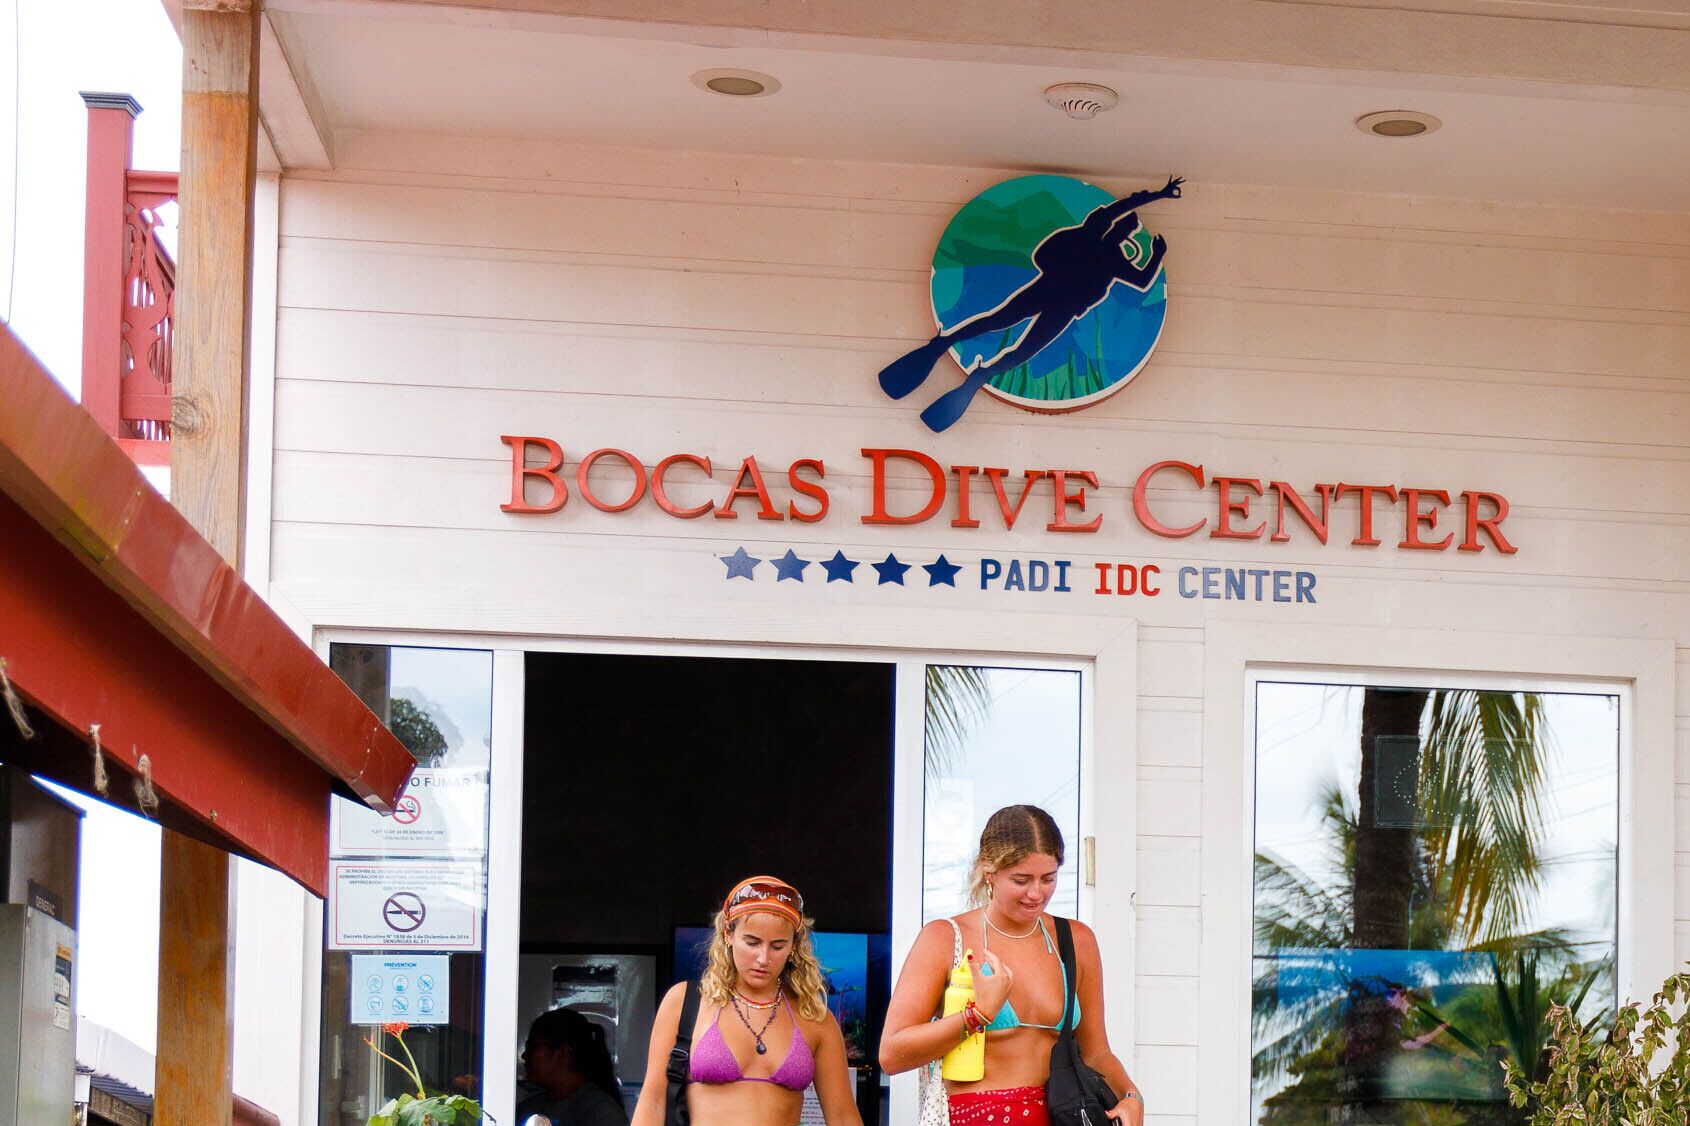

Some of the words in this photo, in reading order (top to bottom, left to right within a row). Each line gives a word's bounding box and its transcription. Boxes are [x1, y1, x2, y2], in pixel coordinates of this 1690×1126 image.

[500, 435, 830, 523] BOCAS
[860, 447, 1103, 532] DIVE
[1133, 460, 1518, 554] CENTER
[980, 558, 1072, 593] PADI
[1095, 563, 1161, 597] IDC
[1178, 565, 1318, 604] CENTER
